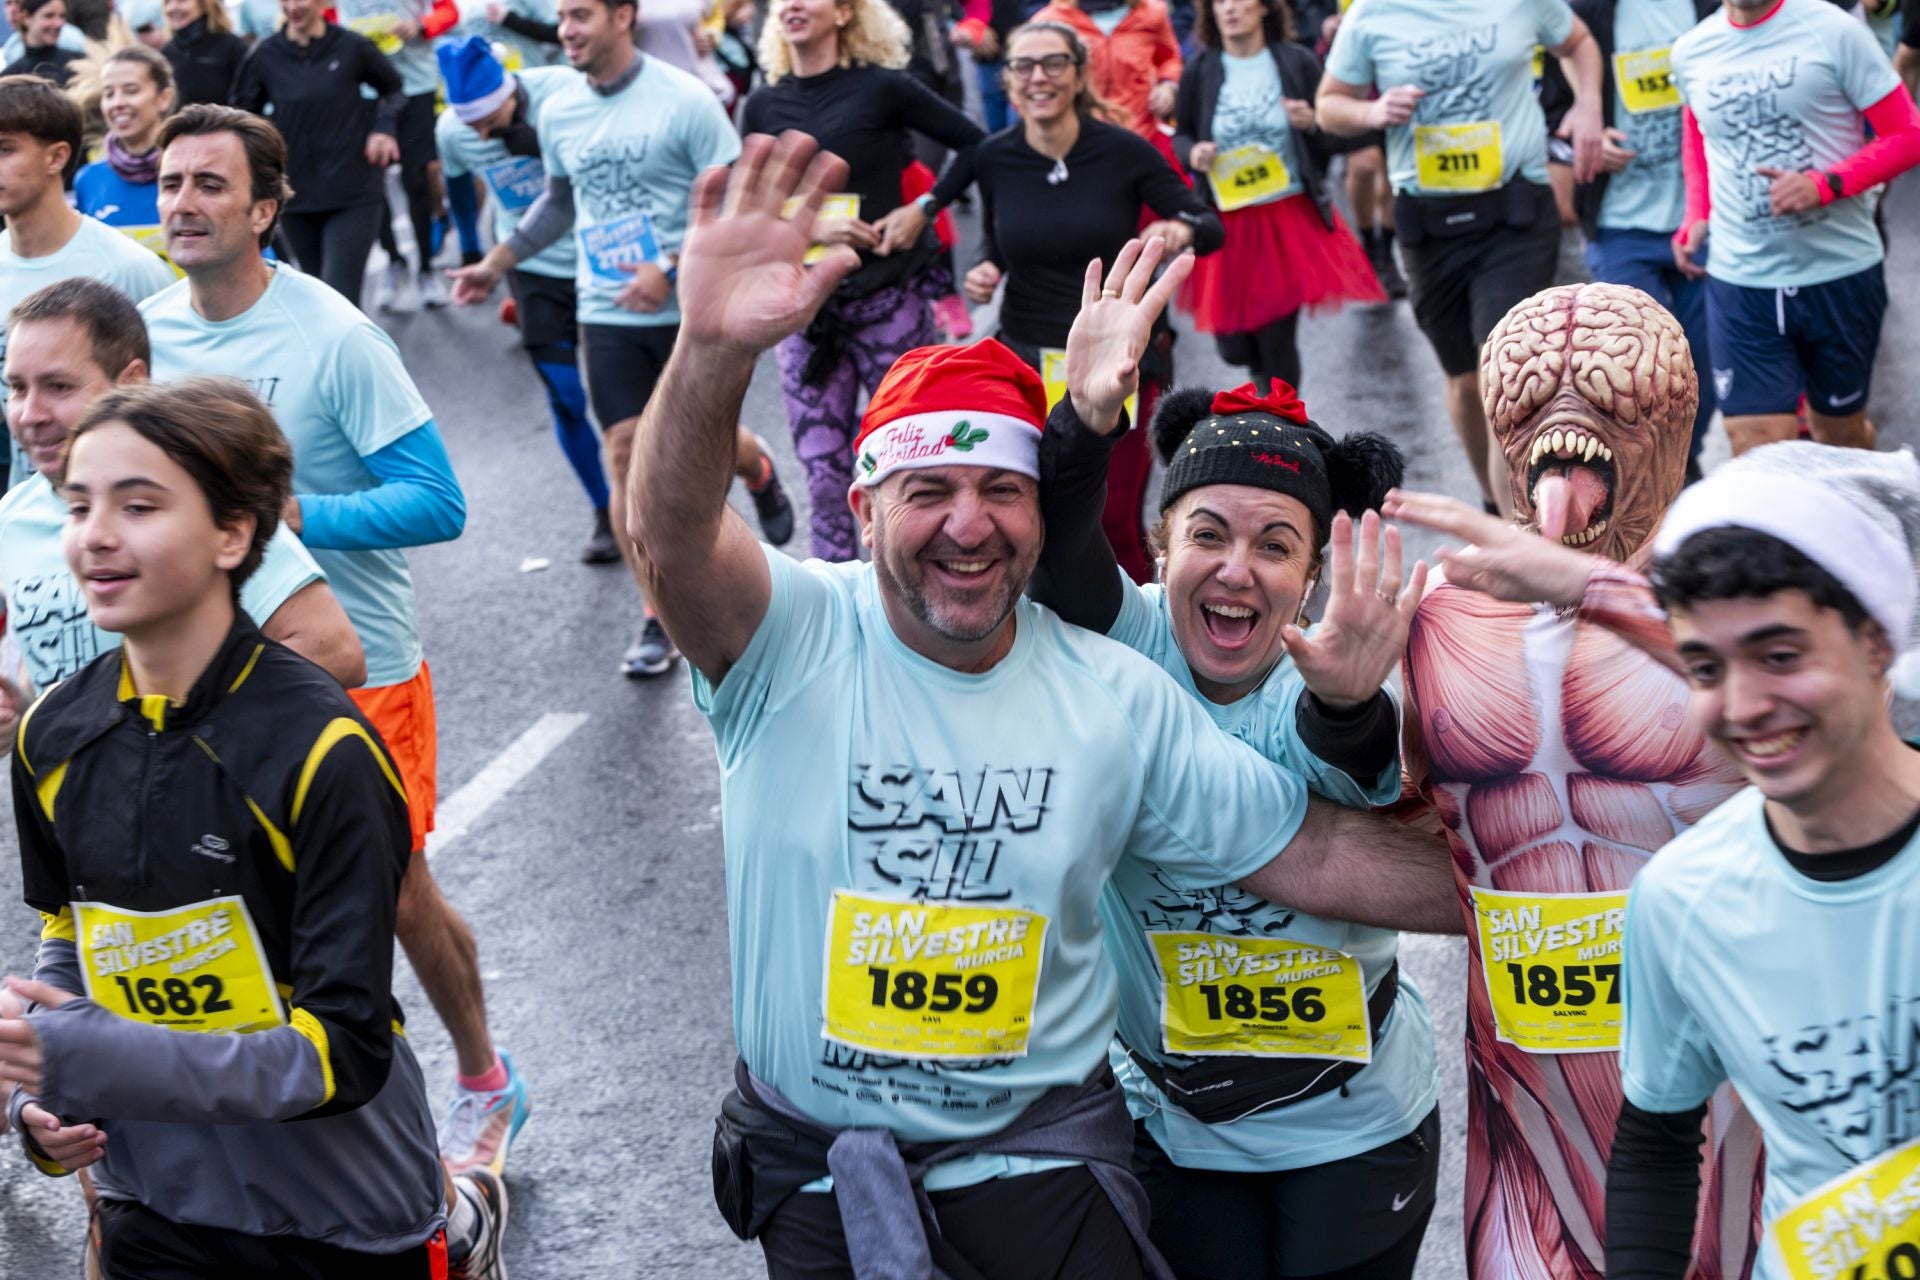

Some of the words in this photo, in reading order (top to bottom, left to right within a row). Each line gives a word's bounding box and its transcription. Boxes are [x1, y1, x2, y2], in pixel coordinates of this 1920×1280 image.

[1437, 153, 1479, 172] 2111
[885, 422, 925, 451] Feliz
[848, 763, 1055, 834] SAN
[866, 838, 1013, 901] SIL
[91, 921, 136, 951] SAN
[852, 911, 928, 939] SAN
[1488, 905, 1542, 935] SAN
[94, 908, 234, 977] SILVESTRE
[169, 936, 239, 975] MURCIA
[847, 917, 1032, 967] SILVESTRE
[954, 944, 1025, 970] MURCIA
[1176, 940, 1240, 963] SAN
[1177, 948, 1343, 986] SILVESTRE
[1274, 964, 1342, 984] MURCIA
[1507, 962, 1623, 1007] 1857
[115, 973, 235, 1017] 1682
[868, 966, 999, 1014] 1859
[1200, 983, 1326, 1022] 1856
[1797, 1181, 1882, 1257] SAN
